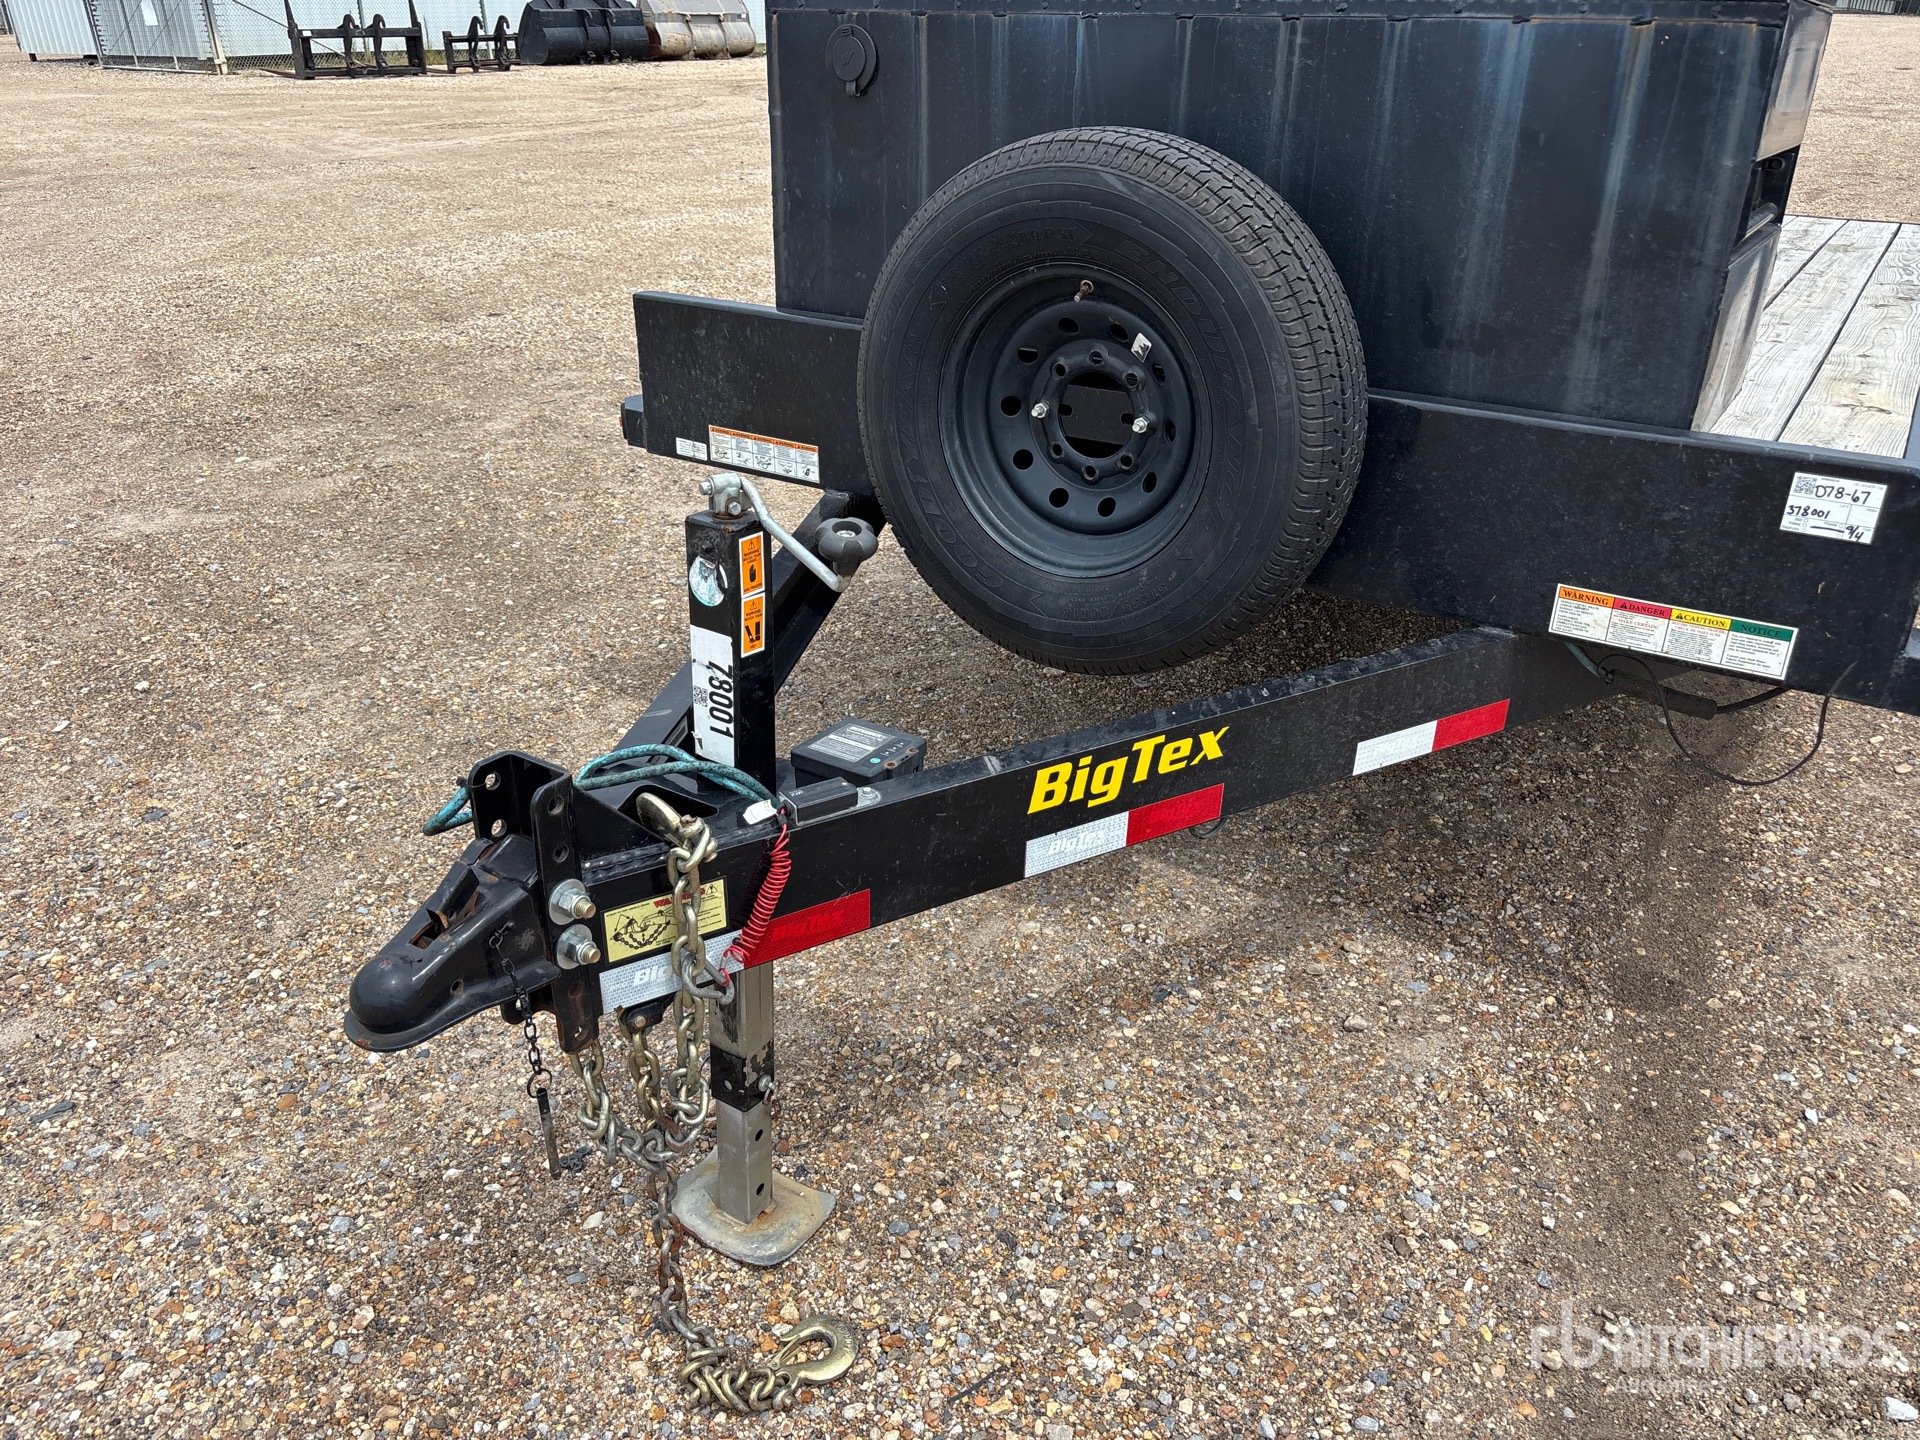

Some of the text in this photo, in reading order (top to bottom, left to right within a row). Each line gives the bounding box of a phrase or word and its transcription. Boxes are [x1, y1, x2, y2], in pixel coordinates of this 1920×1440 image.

[1815, 485, 1871, 505] D78-67
[1786, 505, 1831, 520] 378001
[1845, 525, 1865, 542] 9/4
[1563, 589, 1609, 606] WARNING
[1629, 602, 1666, 617] DANGER
[1683, 613, 1726, 628] CAUTION
[1741, 623, 1781, 638] NOTICE
[708, 660, 734, 739] 78001
[1027, 726, 1230, 815] BigTex
